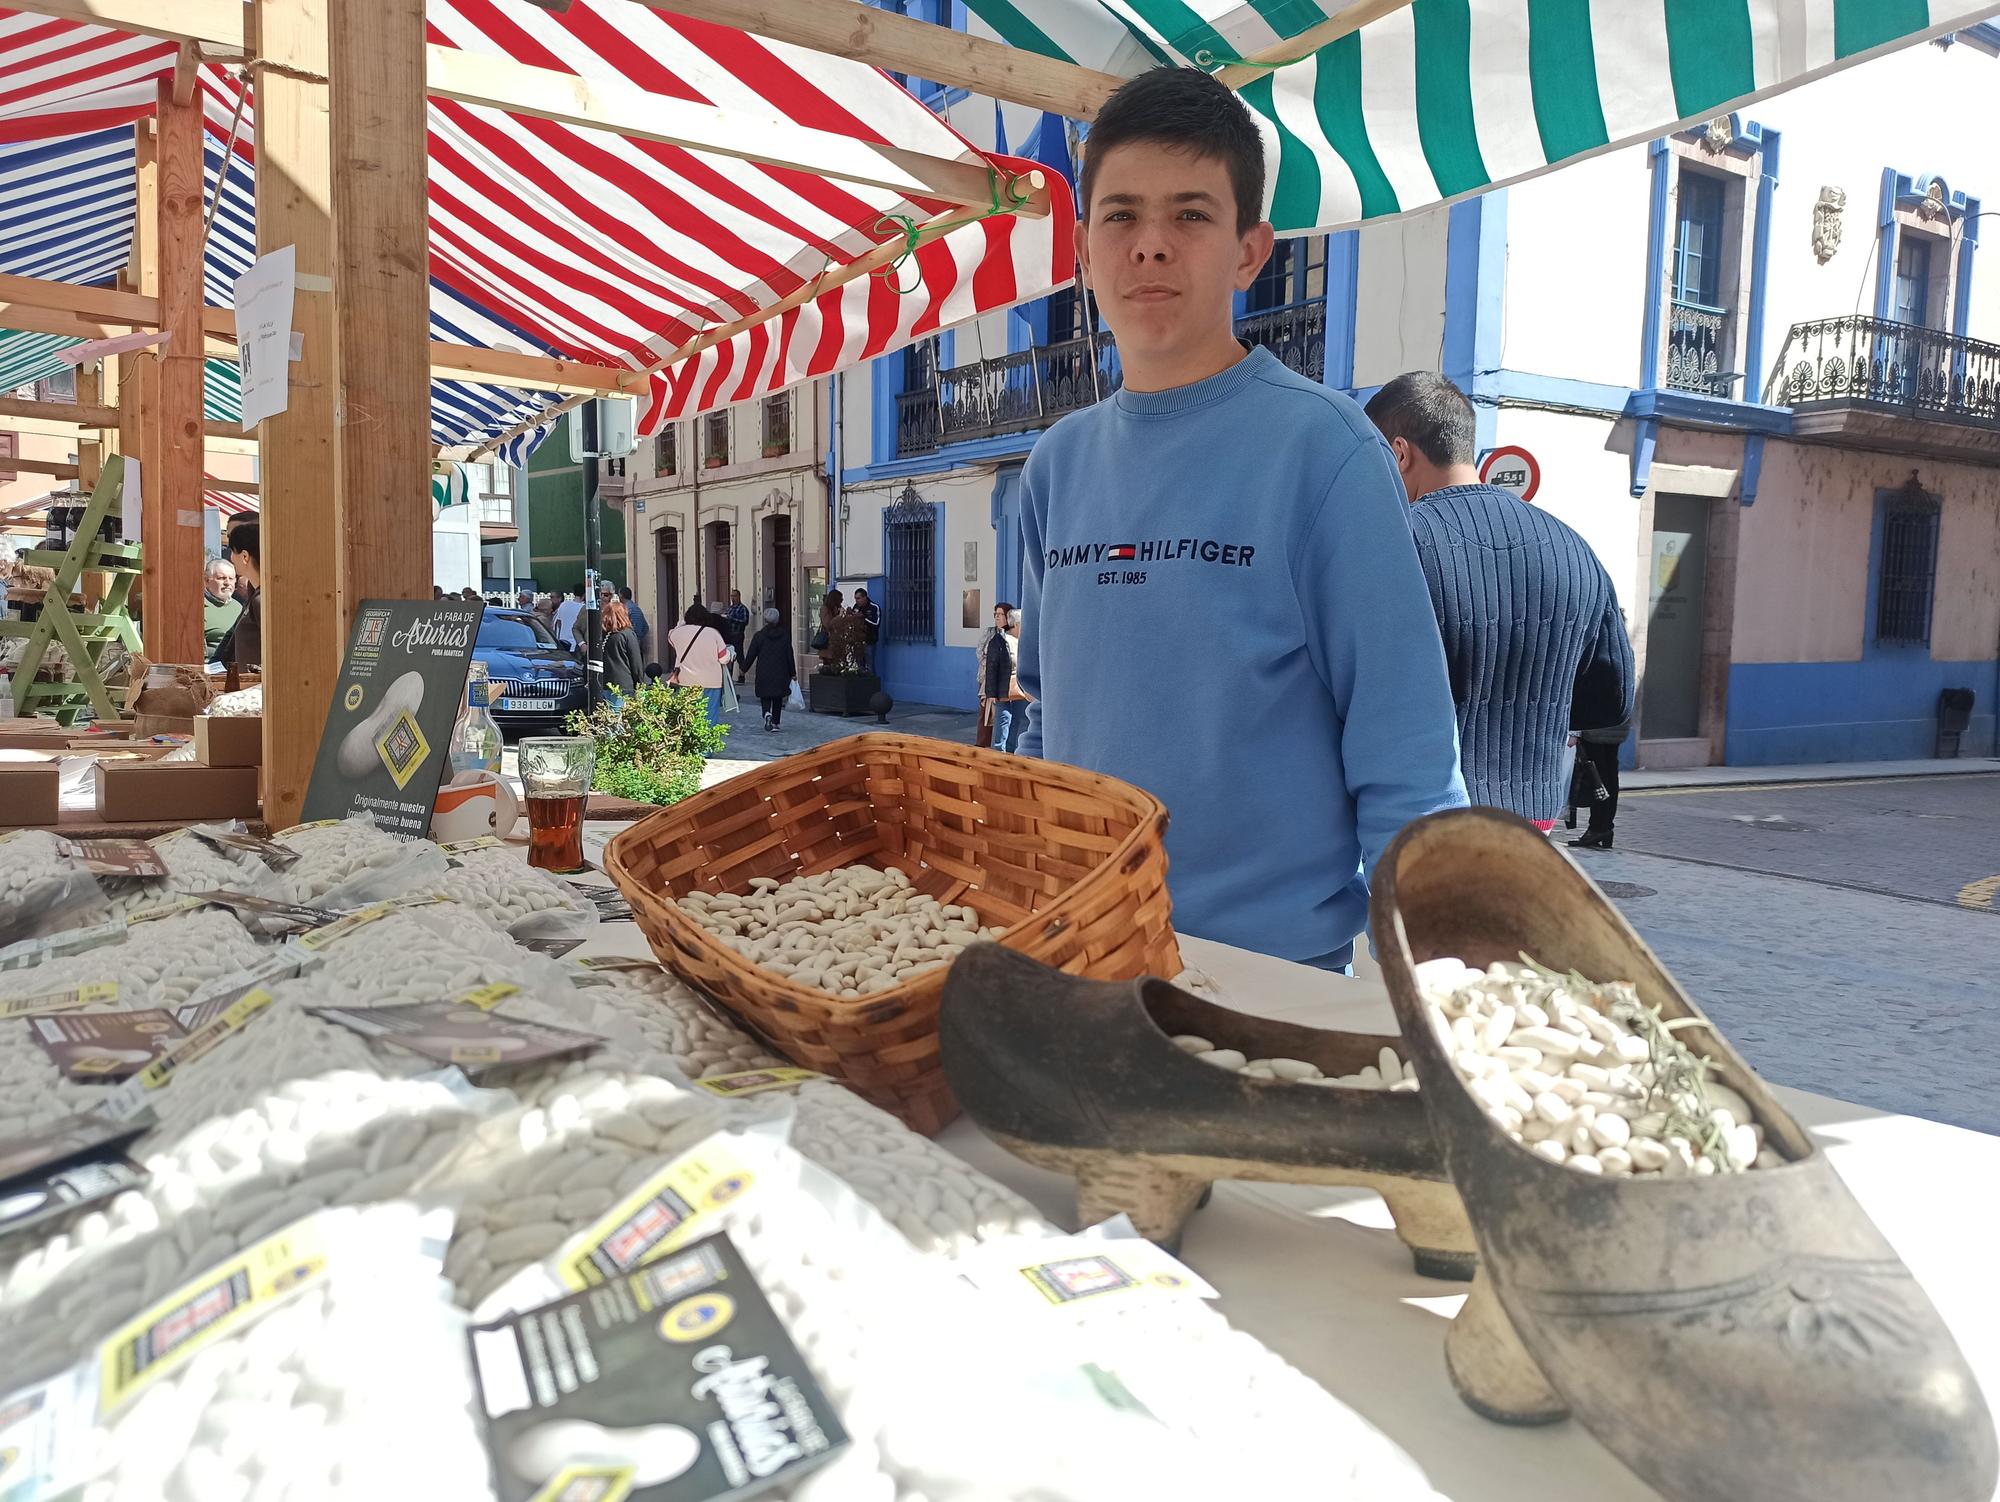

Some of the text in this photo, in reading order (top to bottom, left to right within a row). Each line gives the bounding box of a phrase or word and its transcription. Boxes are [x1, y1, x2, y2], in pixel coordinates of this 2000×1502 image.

[1044, 538, 1256, 570] OMMY HILFIGER
[1097, 570, 1147, 585] EST. 1985
[434, 611, 475, 622] LA FABA DE
[391, 617, 470, 654] Asturias
[431, 648, 465, 657] PURA MANTECA
[510, 700, 554, 709] 9381 LGM
[354, 793, 426, 815] Originalmente nuestra
[400, 816, 422, 830] buena
